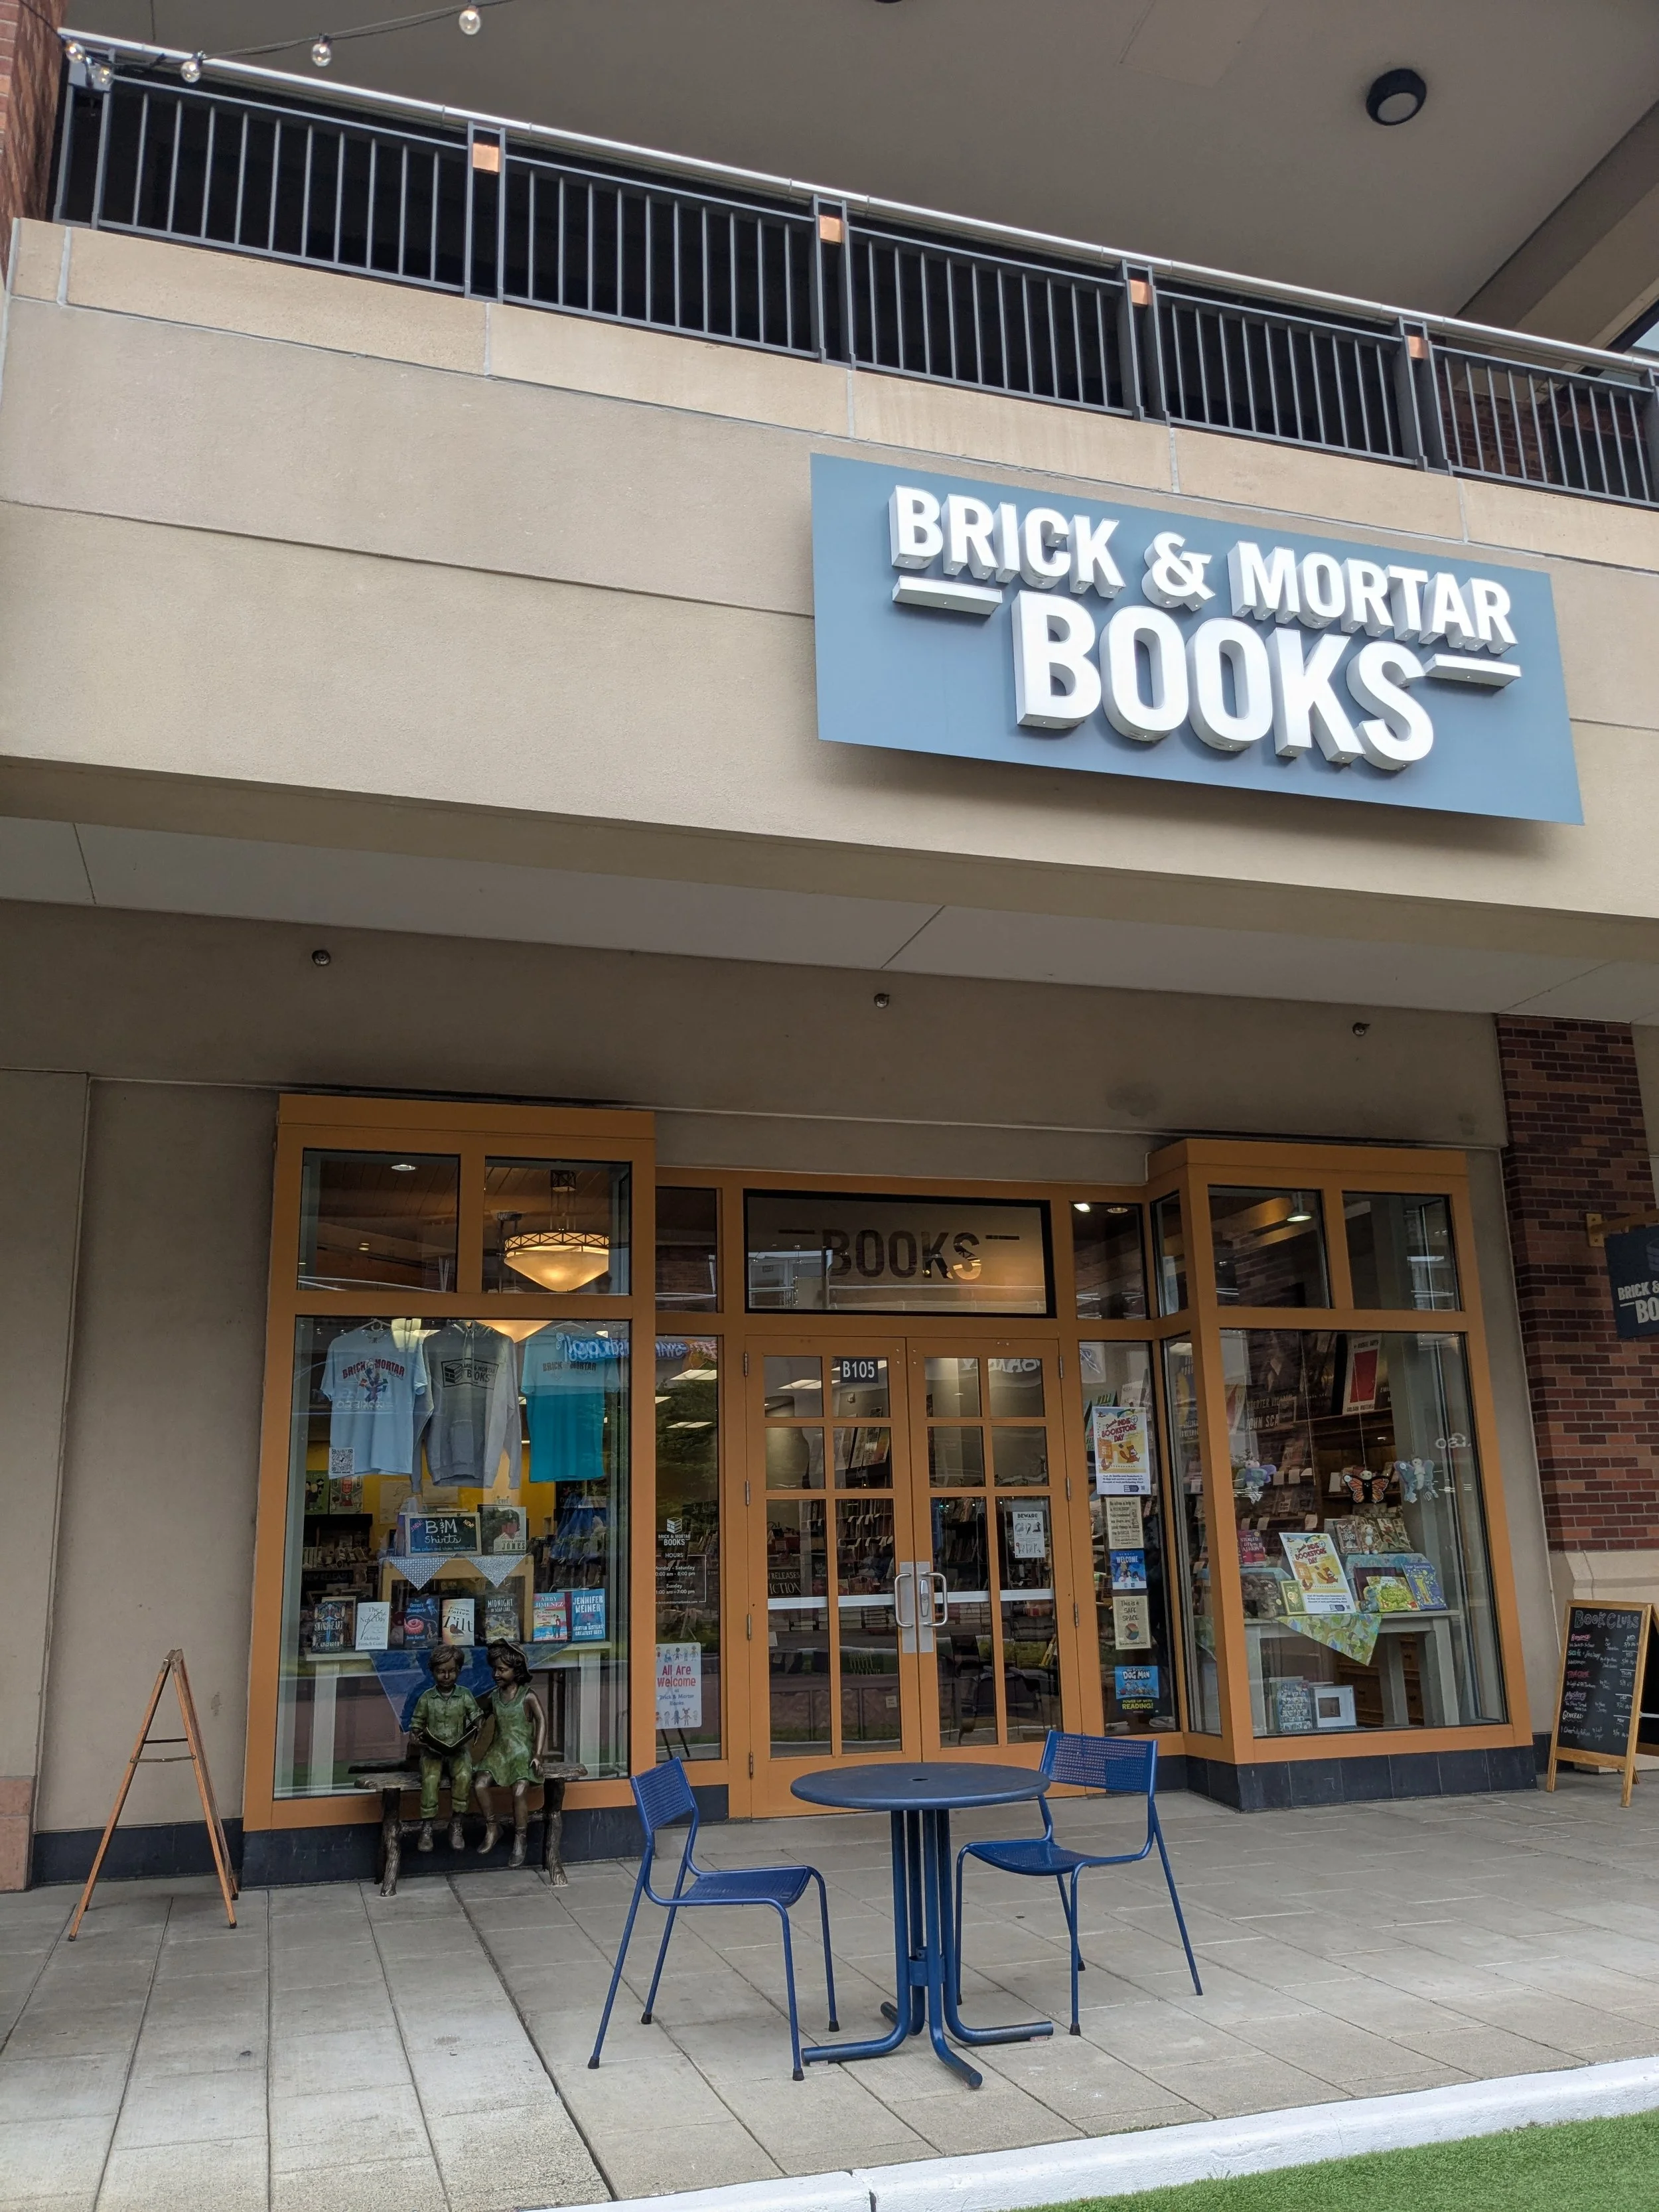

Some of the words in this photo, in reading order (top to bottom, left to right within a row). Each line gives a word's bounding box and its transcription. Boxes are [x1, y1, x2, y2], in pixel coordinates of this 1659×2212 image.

[889, 485, 1125, 599] BRICK
[1141, 531, 1216, 611] &
[1227, 540, 1518, 654] MORTAR
[1011, 590, 1435, 772] BOOKS
[822, 1229, 981, 1281] BOOKS
[1617, 1282, 1651, 1301] BRICK
[467, 1369, 491, 1382] BOKS
[843, 1361, 875, 1378] B105
[1118, 1418, 1131, 1426] INDIE
[1102, 1424, 1137, 1438] BOOKSTORE
[425, 1534, 461, 1544] Shirts
[1295, 1548, 1327, 1560] BOOKSTORE
[769, 1582, 802, 1595] ICTION
[488, 1598, 513, 1608] MIDNIGHT
[573, 1595, 603, 1605] JENNIFER
[575, 1603, 601, 1613] WEINER
[443, 1615, 474, 1633] Tilt
[662, 1664, 672, 1676] All
[676, 1665, 691, 1676] Are
[657, 1677, 696, 1688] Welcome
